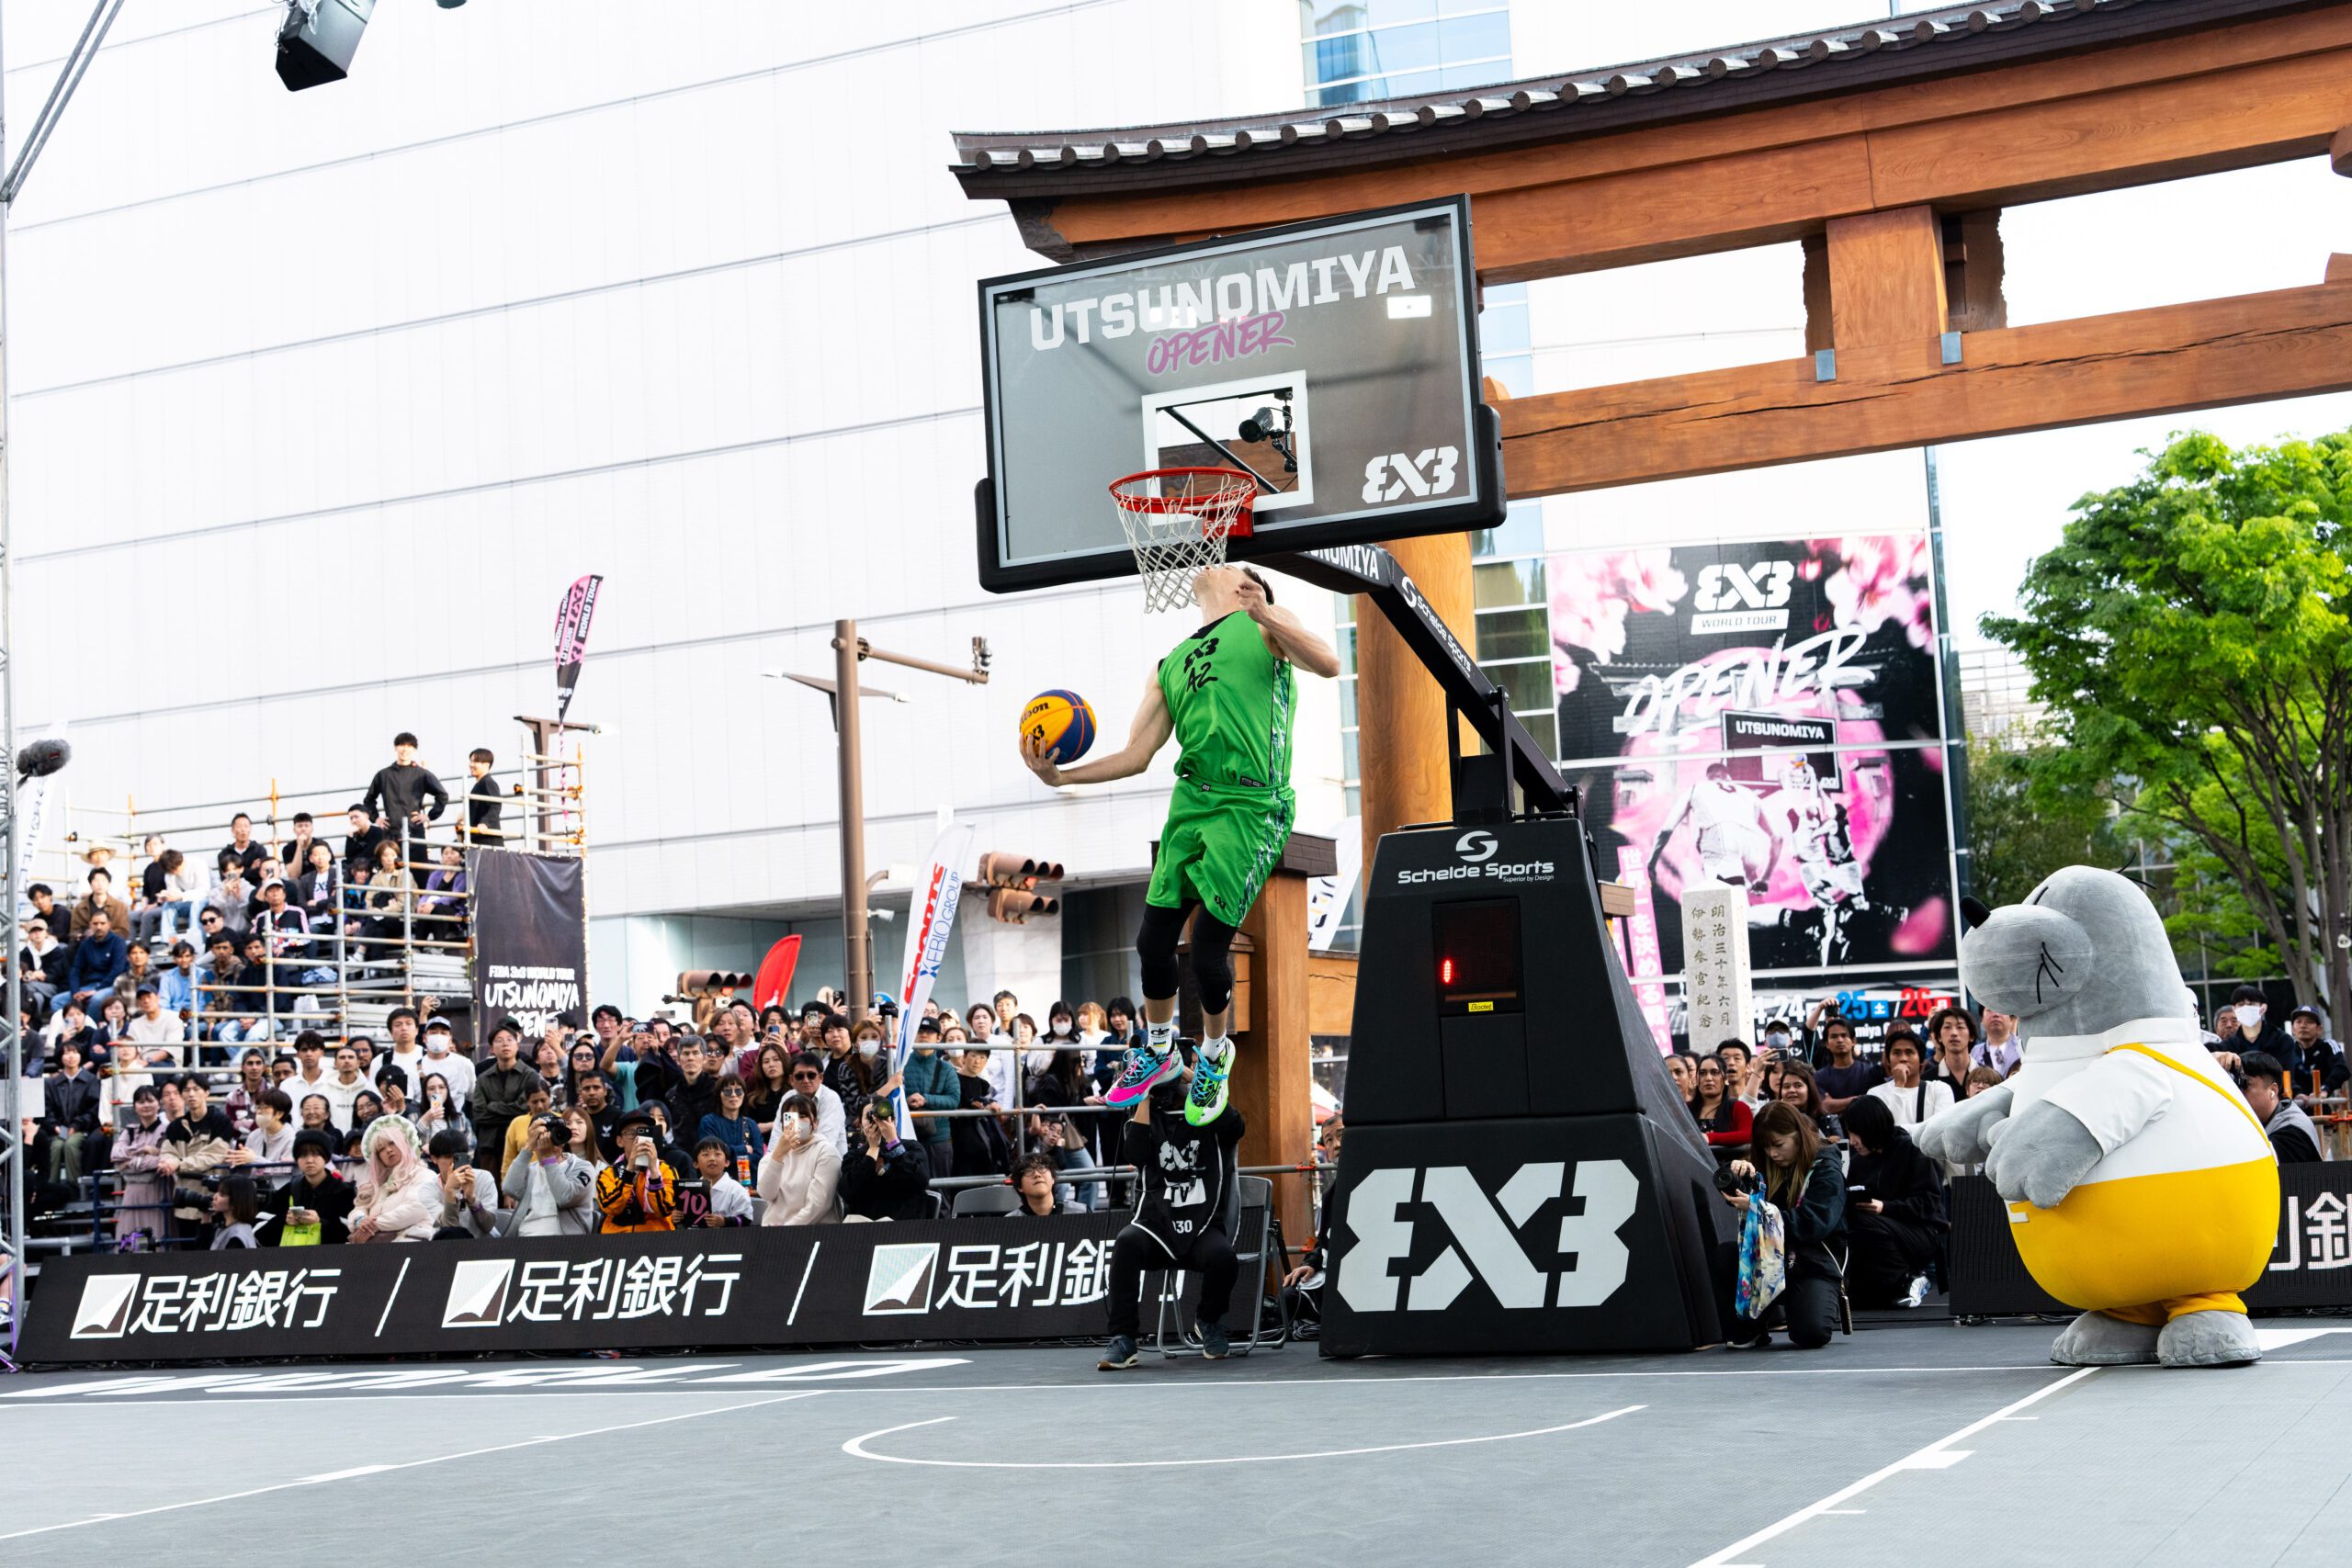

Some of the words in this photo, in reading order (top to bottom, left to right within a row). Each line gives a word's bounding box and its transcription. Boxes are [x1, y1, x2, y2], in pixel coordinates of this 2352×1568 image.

[1030, 245, 1416, 352] UTSUNOMIYA
[1147, 311, 1295, 375] OPENER
[578, 604, 593, 638] WORLD
[586, 578, 598, 605] TOUR
[1417, 596, 1447, 640] Schelde
[1447, 637, 1472, 671] Sports
[1702, 616, 1744, 628] WORLD
[1747, 615, 1777, 626] TOUR
[1623, 624, 1875, 737] OPENER
[1736, 720, 1825, 739] UTSUNOMIYA
[1397, 865, 1480, 885] Schelde
[1485, 861, 1555, 879] Sports
[484, 978, 580, 1012] UTSUNOMIYA
[489, 964, 509, 978] FIBA
[526, 966, 556, 980] WORLD
[556, 967, 575, 981] TOUR
[1711, 905, 1730, 1027] 明治三十年六月
[1837, 989, 1869, 1021] 25
[1900, 987, 1933, 1018] 26
[1170, 1186, 1190, 1203] TV
[1172, 1219, 1193, 1234] 30
[130, 1269, 342, 1334] 足利銀行
[507, 1253, 742, 1324] 足利銀行
[935, 1238, 1185, 1312] 足利銀
